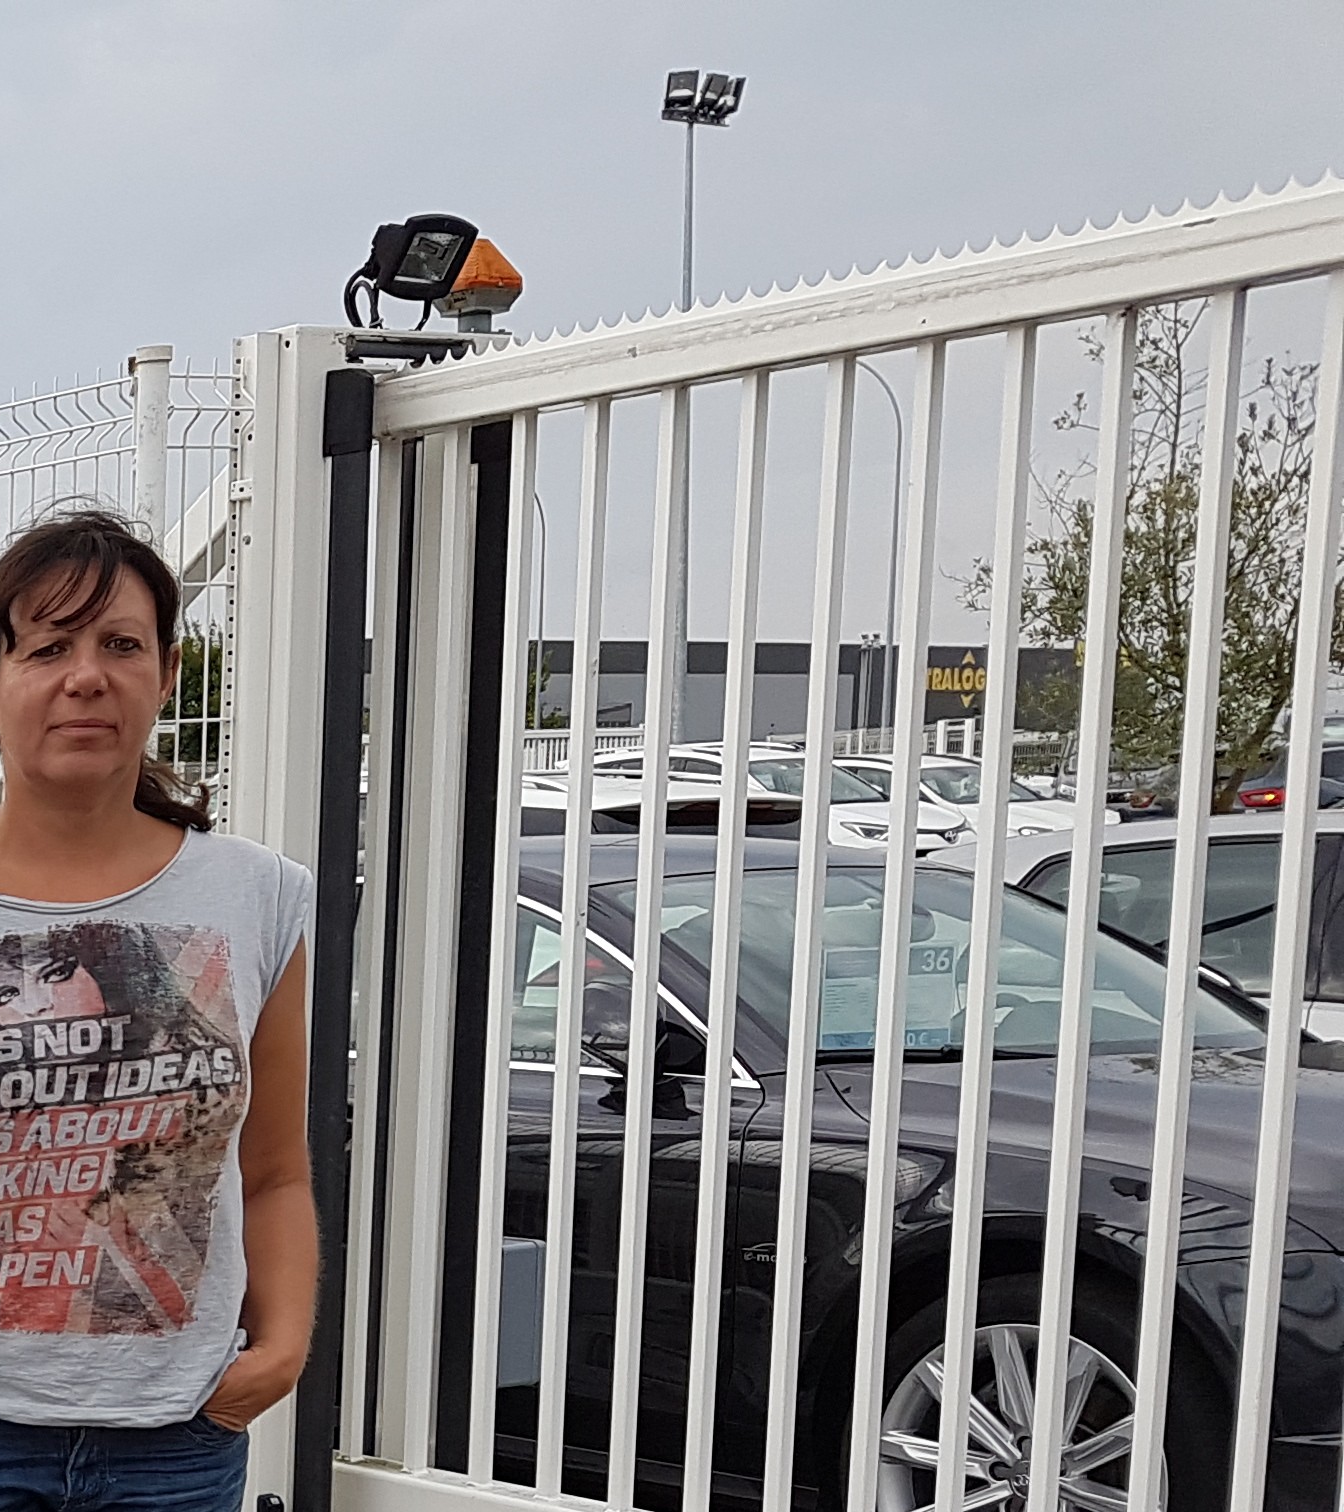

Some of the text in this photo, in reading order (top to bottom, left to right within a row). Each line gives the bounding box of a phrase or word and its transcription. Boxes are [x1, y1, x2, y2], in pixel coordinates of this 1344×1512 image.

[921, 950, 950, 972] 36
[34, 1015, 132, 1059] NOT
[104, 1048, 241, 1099] IDEAS.
[19, 1102, 180, 1152] ABOUT
